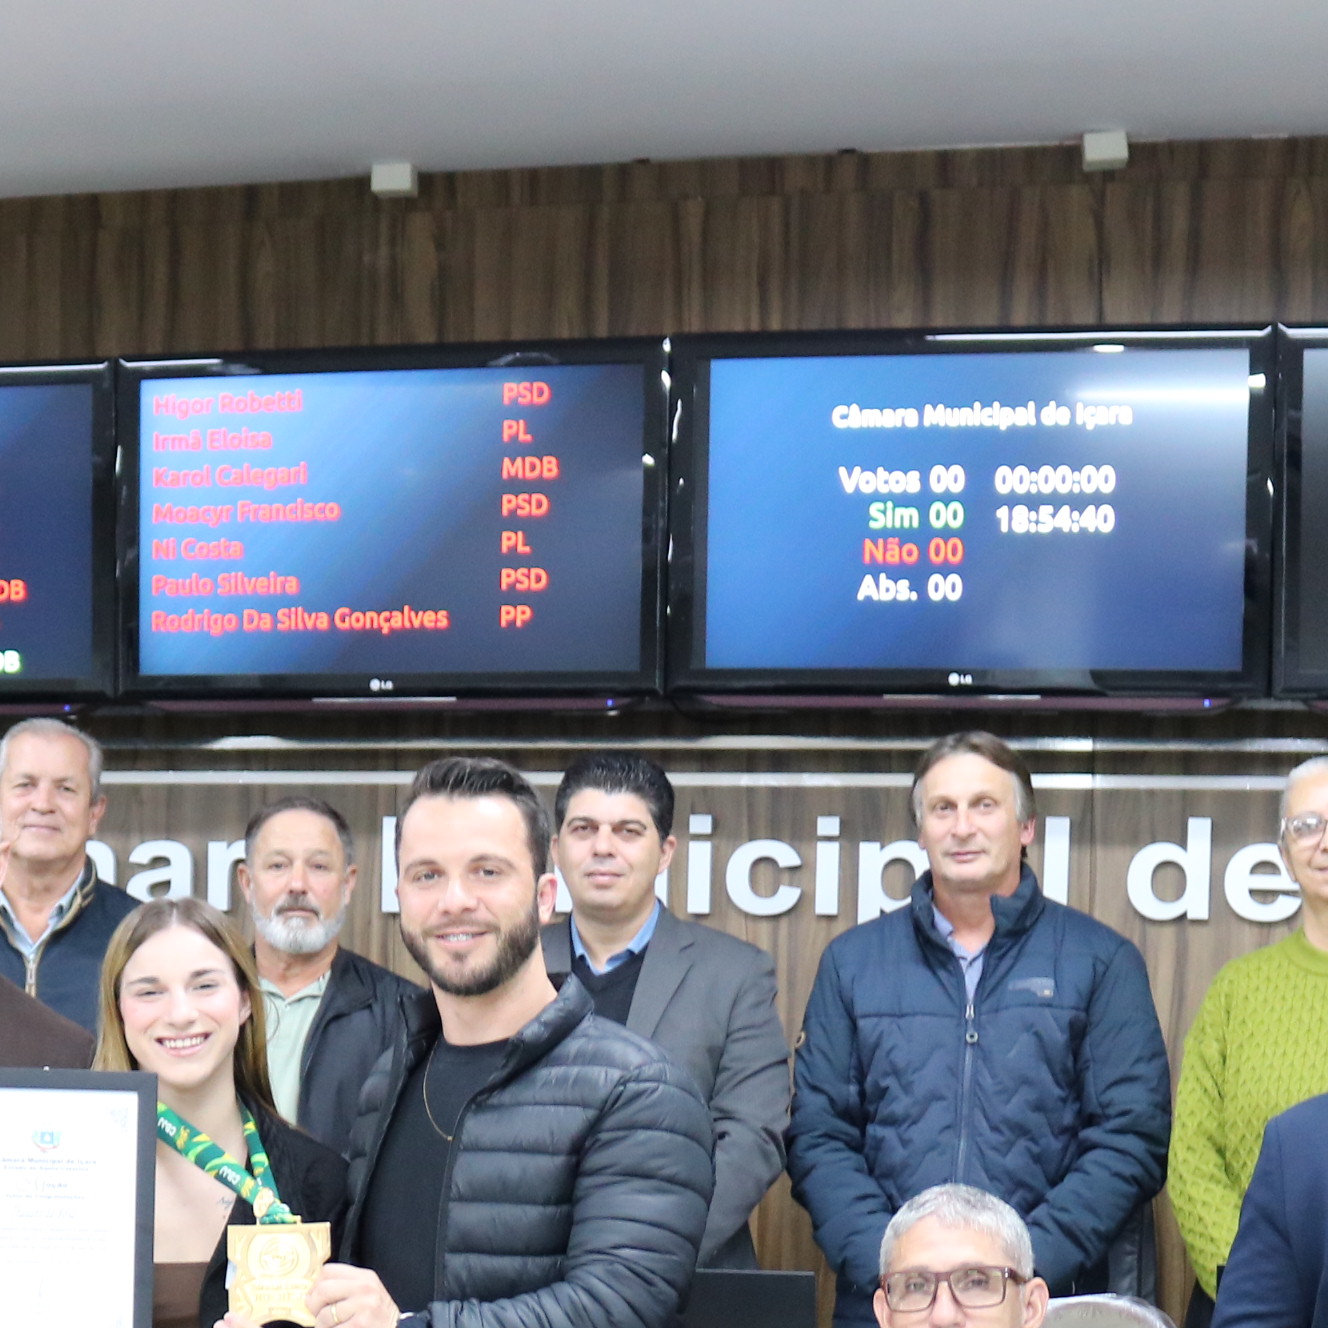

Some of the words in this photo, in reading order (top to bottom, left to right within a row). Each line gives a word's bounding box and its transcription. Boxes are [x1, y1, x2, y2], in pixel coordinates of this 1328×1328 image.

[153, 394, 214, 420] Higor
[219, 389, 302, 413] Robetti
[503, 381, 551, 406] PSD
[832, 403, 919, 429] Câmara
[923, 401, 1036, 431] Municipal
[1040, 401, 1071, 426] de
[1076, 402, 1133, 430] Içara
[207, 427, 272, 450] Eloisa
[502, 419, 533, 442] PL
[153, 464, 211, 488] Karol
[216, 461, 307, 490] Calegari
[502, 456, 559, 480] MDB
[839, 466, 921, 493] Votos
[929, 464, 965, 493] 00
[995, 465, 1116, 494] 00:00:00
[152, 503, 232, 527] Moacyr
[238, 498, 341, 522] Francisco
[502, 493, 550, 517] PSD
[868, 501, 919, 529] Sim
[929, 501, 964, 528] 00
[995, 504, 1116, 533] 18:54:40
[152, 537, 176, 559] Ni
[181, 538, 243, 559] Costa
[501, 531, 531, 554] PL
[863, 537, 920, 565] Não
[928, 537, 964, 565] 00
[152, 573, 214, 595] Paulo
[218, 571, 299, 595] Silveira
[501, 567, 549, 591] PSD
[857, 573, 918, 601] Abs.
[927, 573, 963, 602] 00
[151, 609, 238, 636] Rodrigo
[243, 609, 272, 631] Da
[277, 606, 329, 630] Silva
[334, 605, 449, 634] Gonçalves
[500, 605, 533, 628] PP
